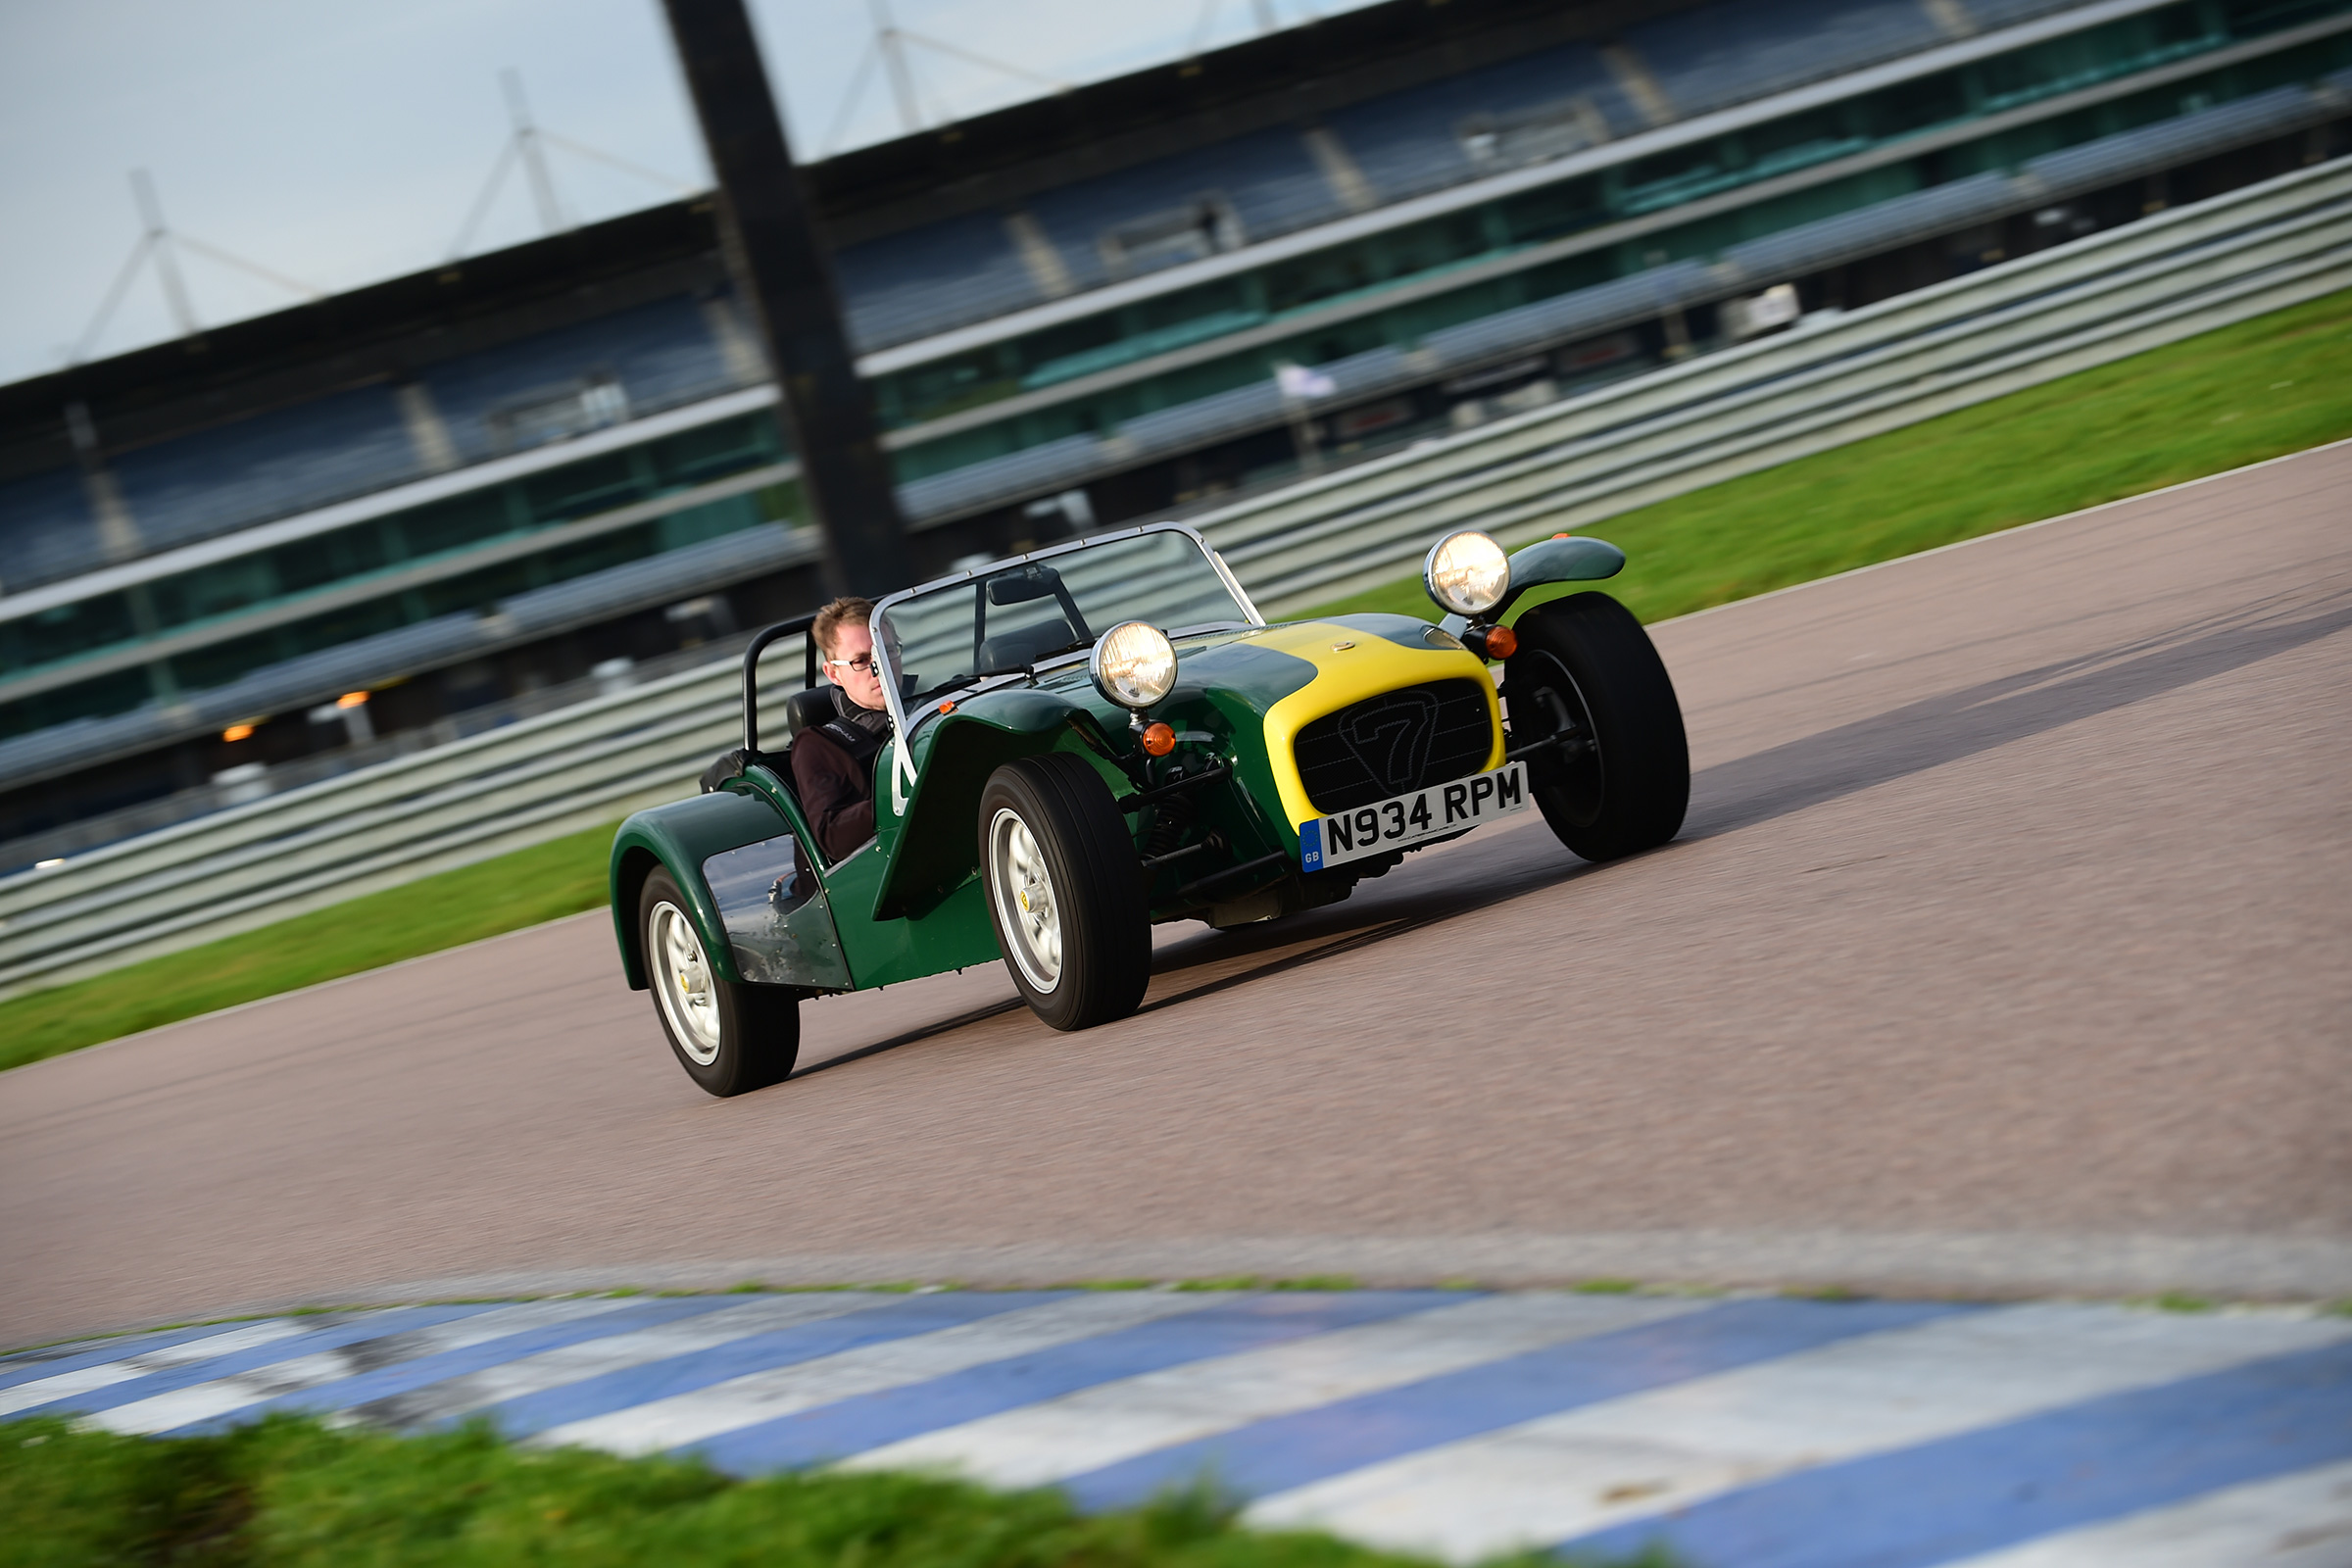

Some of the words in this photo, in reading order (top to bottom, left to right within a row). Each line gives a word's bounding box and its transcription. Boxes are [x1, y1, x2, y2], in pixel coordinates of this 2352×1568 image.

[1351, 701, 1429, 784] 7
[1327, 794, 1432, 856] N934
[1444, 767, 1521, 823] RPM
[1305, 851, 1319, 863] GB
